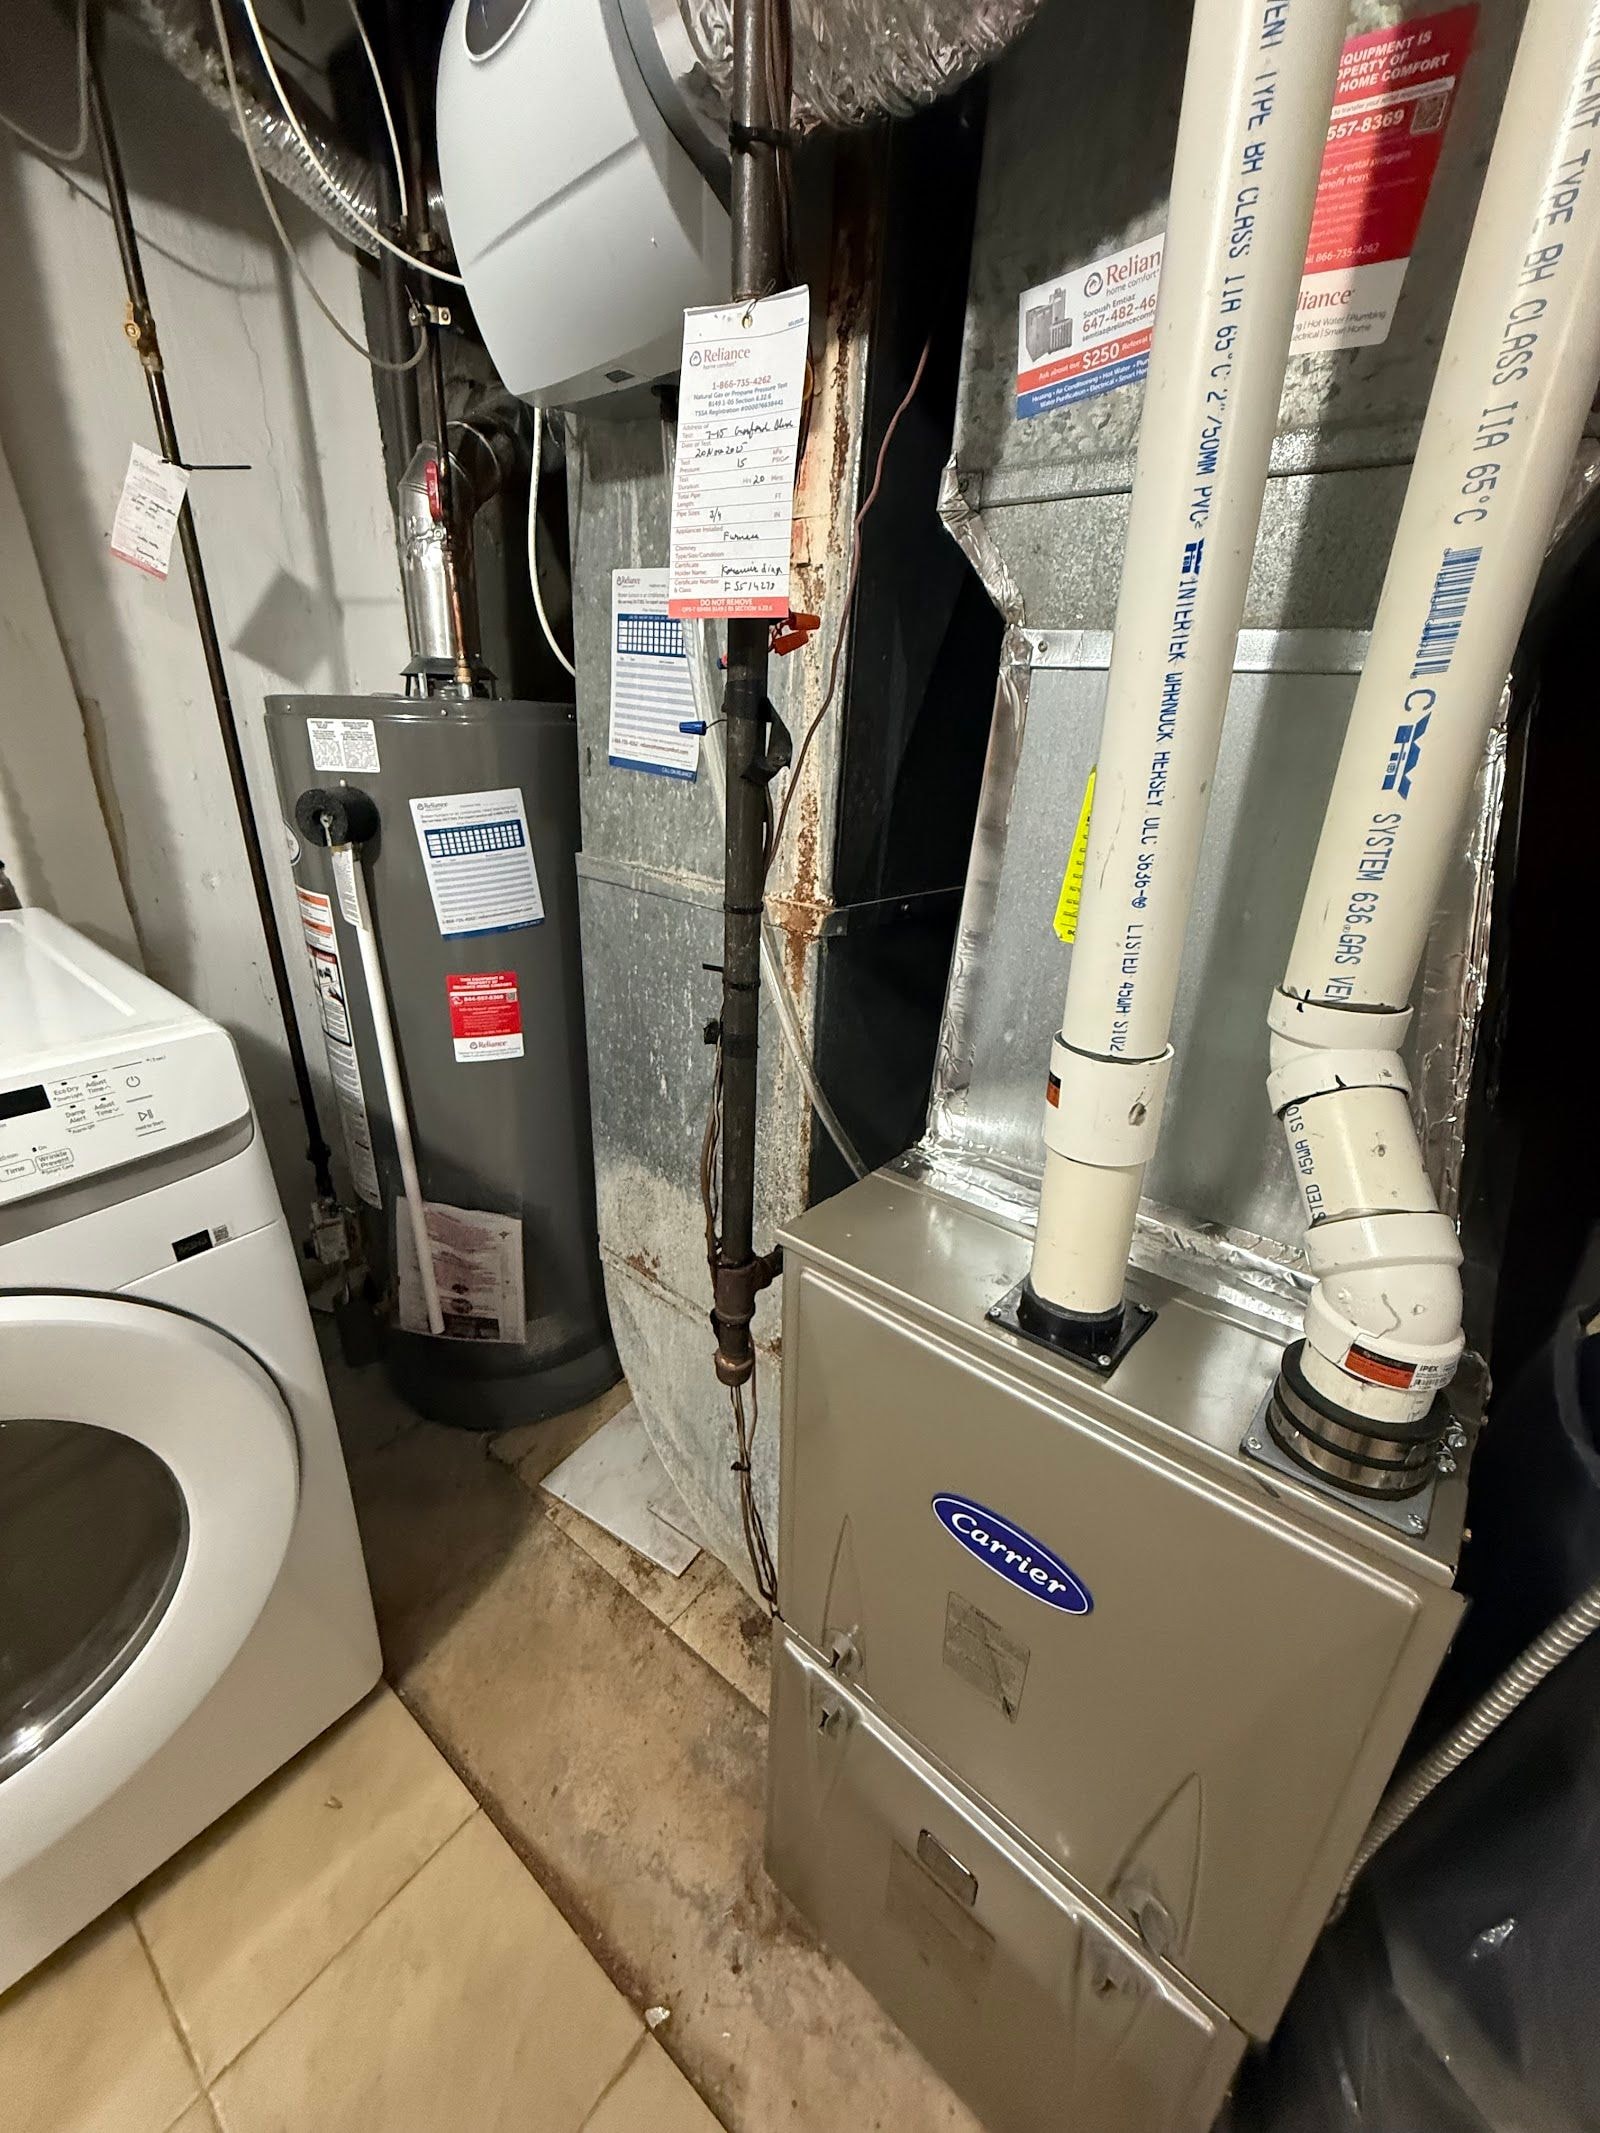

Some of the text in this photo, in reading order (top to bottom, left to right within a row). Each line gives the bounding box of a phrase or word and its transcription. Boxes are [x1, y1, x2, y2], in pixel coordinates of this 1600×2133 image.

[1417, 30, 1432, 46] IS
[1339, 72, 1380, 93] HOME
[1381, 53, 1450, 82] COMFORT
[1547, 148, 1591, 226] TYPE
[1518, 242, 1564, 288] BH
[1106, 283, 1127, 296] home
[1492, 298, 1547, 386] CLASS
[703, 347, 751, 364] Reliance
[1082, 342, 1119, 370] $250
[712, 375, 772, 390] 1-866-735-4262
[701, 598, 710, 606] DO
[1356, 813, 1402, 882] SYSTEM
[86, 1079, 107, 1088] Adjust
[88, 1086, 104, 1094] Time
[94, 1101, 115, 1110] Adjust
[70, 1115, 86, 1123] Alert
[39, 1151, 67, 1162] Wrinkle
[5, 1165, 25, 1175] Time
[951, 1513, 1067, 1594] Carrier
